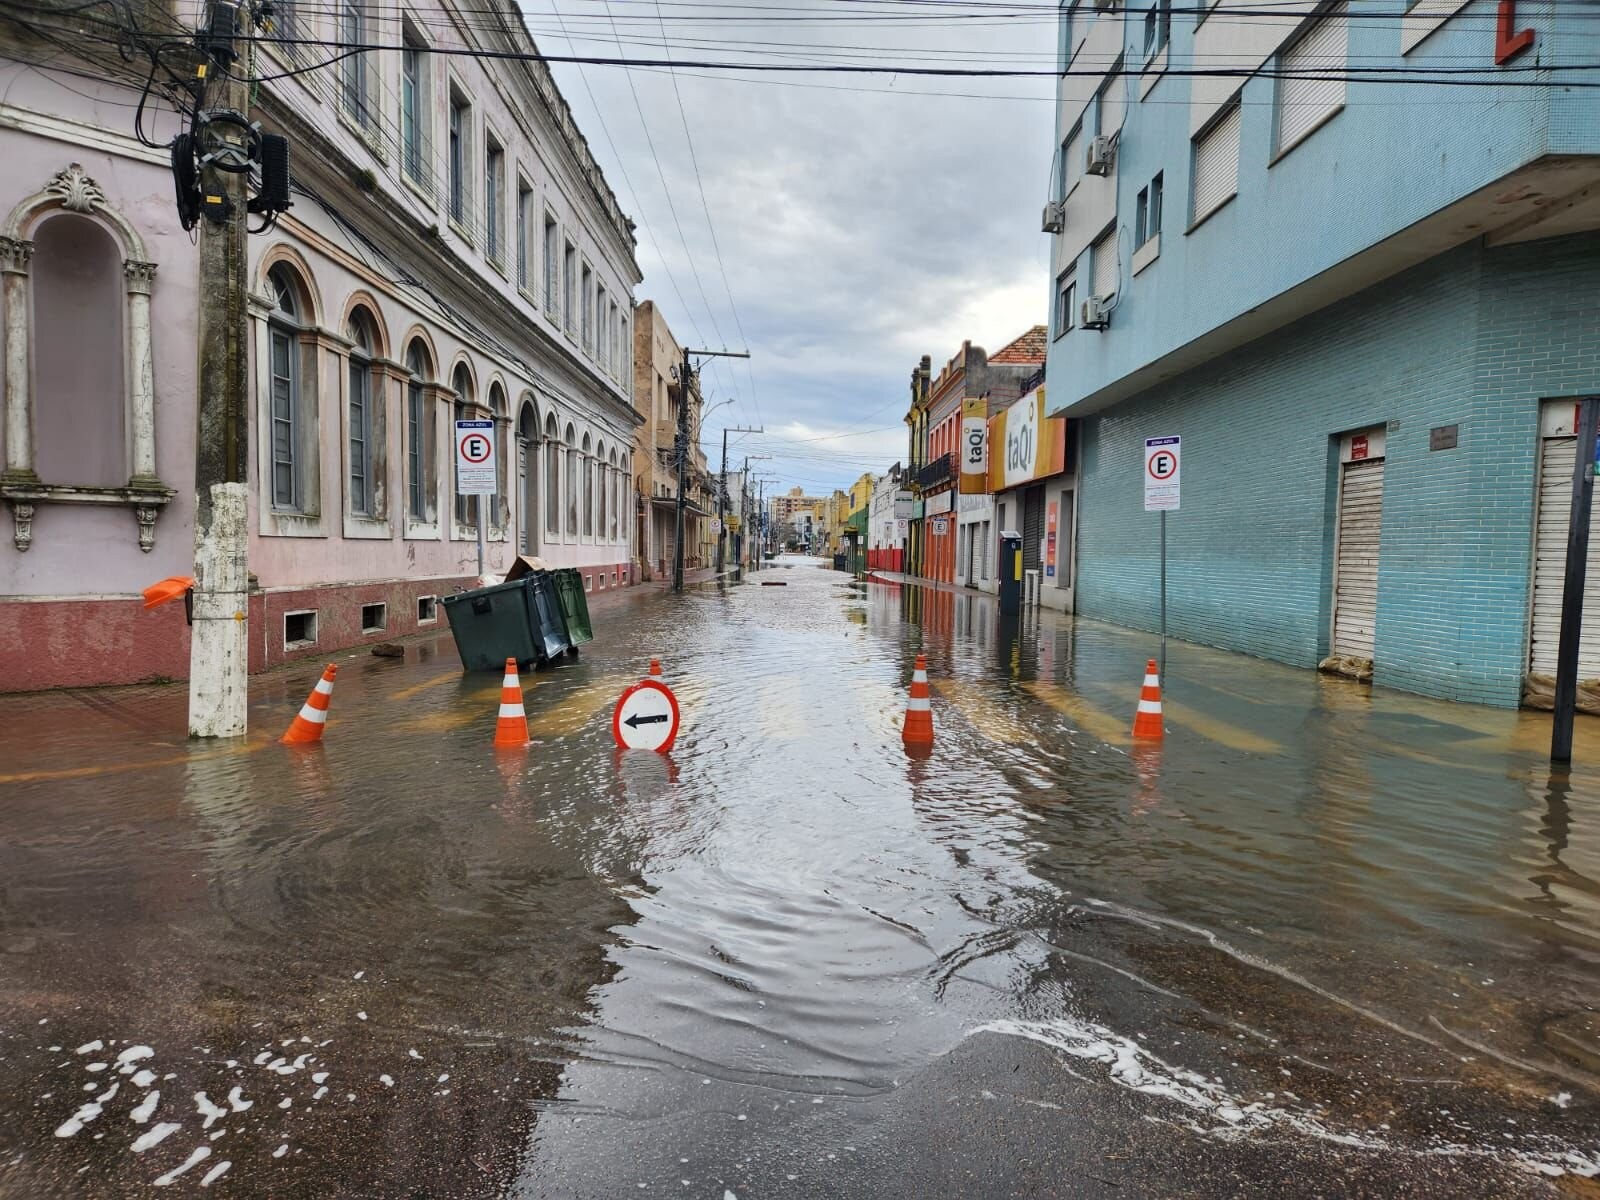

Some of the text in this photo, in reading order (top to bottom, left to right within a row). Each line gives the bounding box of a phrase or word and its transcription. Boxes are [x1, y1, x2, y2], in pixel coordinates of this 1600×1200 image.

[470, 440, 481, 457] E
[964, 427, 985, 465] taQi
[1008, 402, 1034, 472] taQi
[1157, 456, 1168, 474] E
